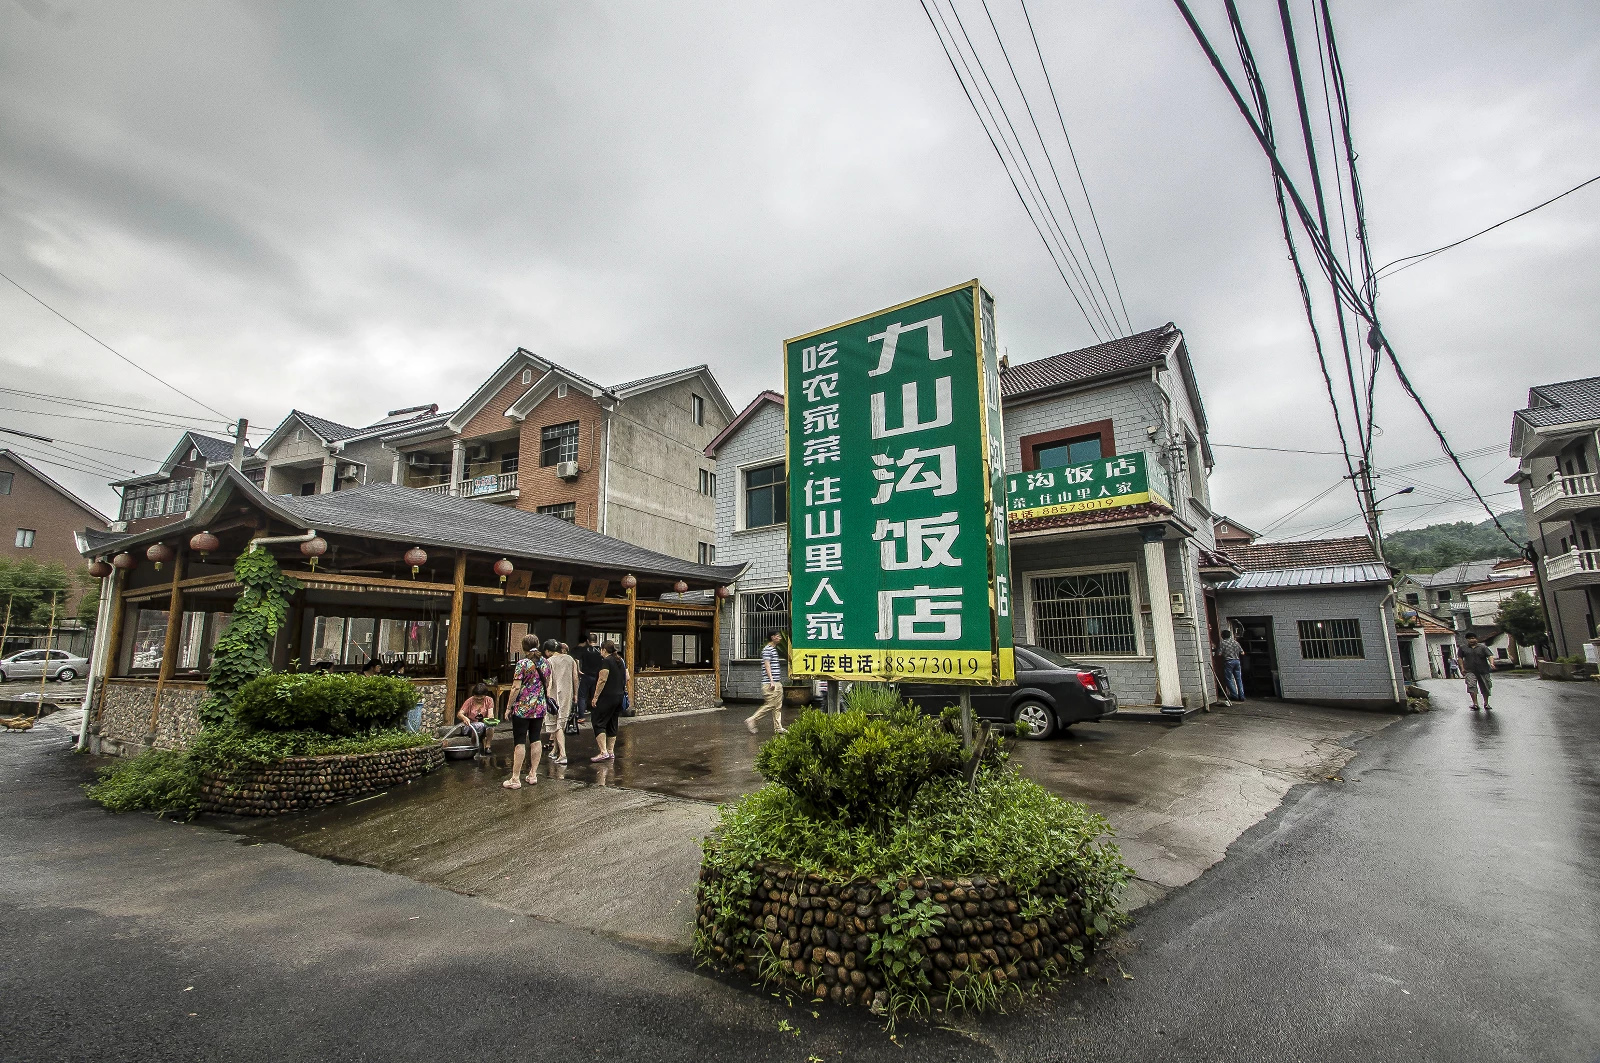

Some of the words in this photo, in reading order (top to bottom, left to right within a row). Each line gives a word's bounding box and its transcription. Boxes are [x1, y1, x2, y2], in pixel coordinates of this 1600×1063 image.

[867, 315, 962, 642] 九山沟饭店
